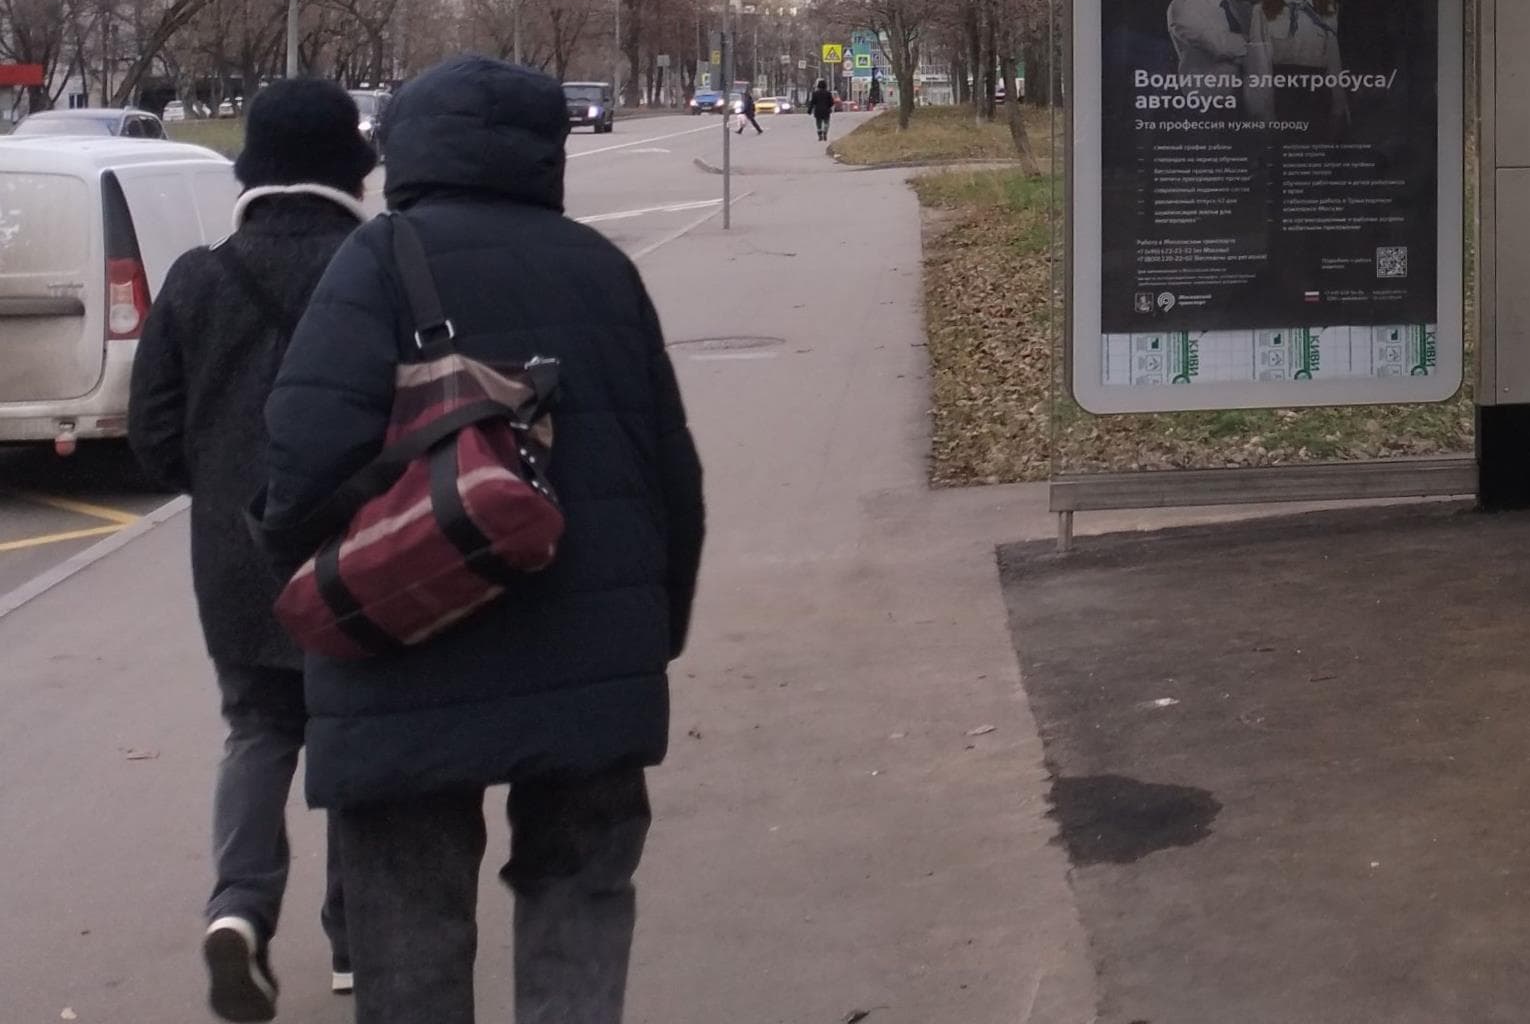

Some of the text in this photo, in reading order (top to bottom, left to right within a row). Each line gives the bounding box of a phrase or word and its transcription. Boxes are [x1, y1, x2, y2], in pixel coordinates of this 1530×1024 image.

[1134, 68, 1398, 93] Водитель электробуса/
[1135, 90, 1238, 114] автобуса
[1135, 118, 1310, 133] Эта профессия нужна городу
